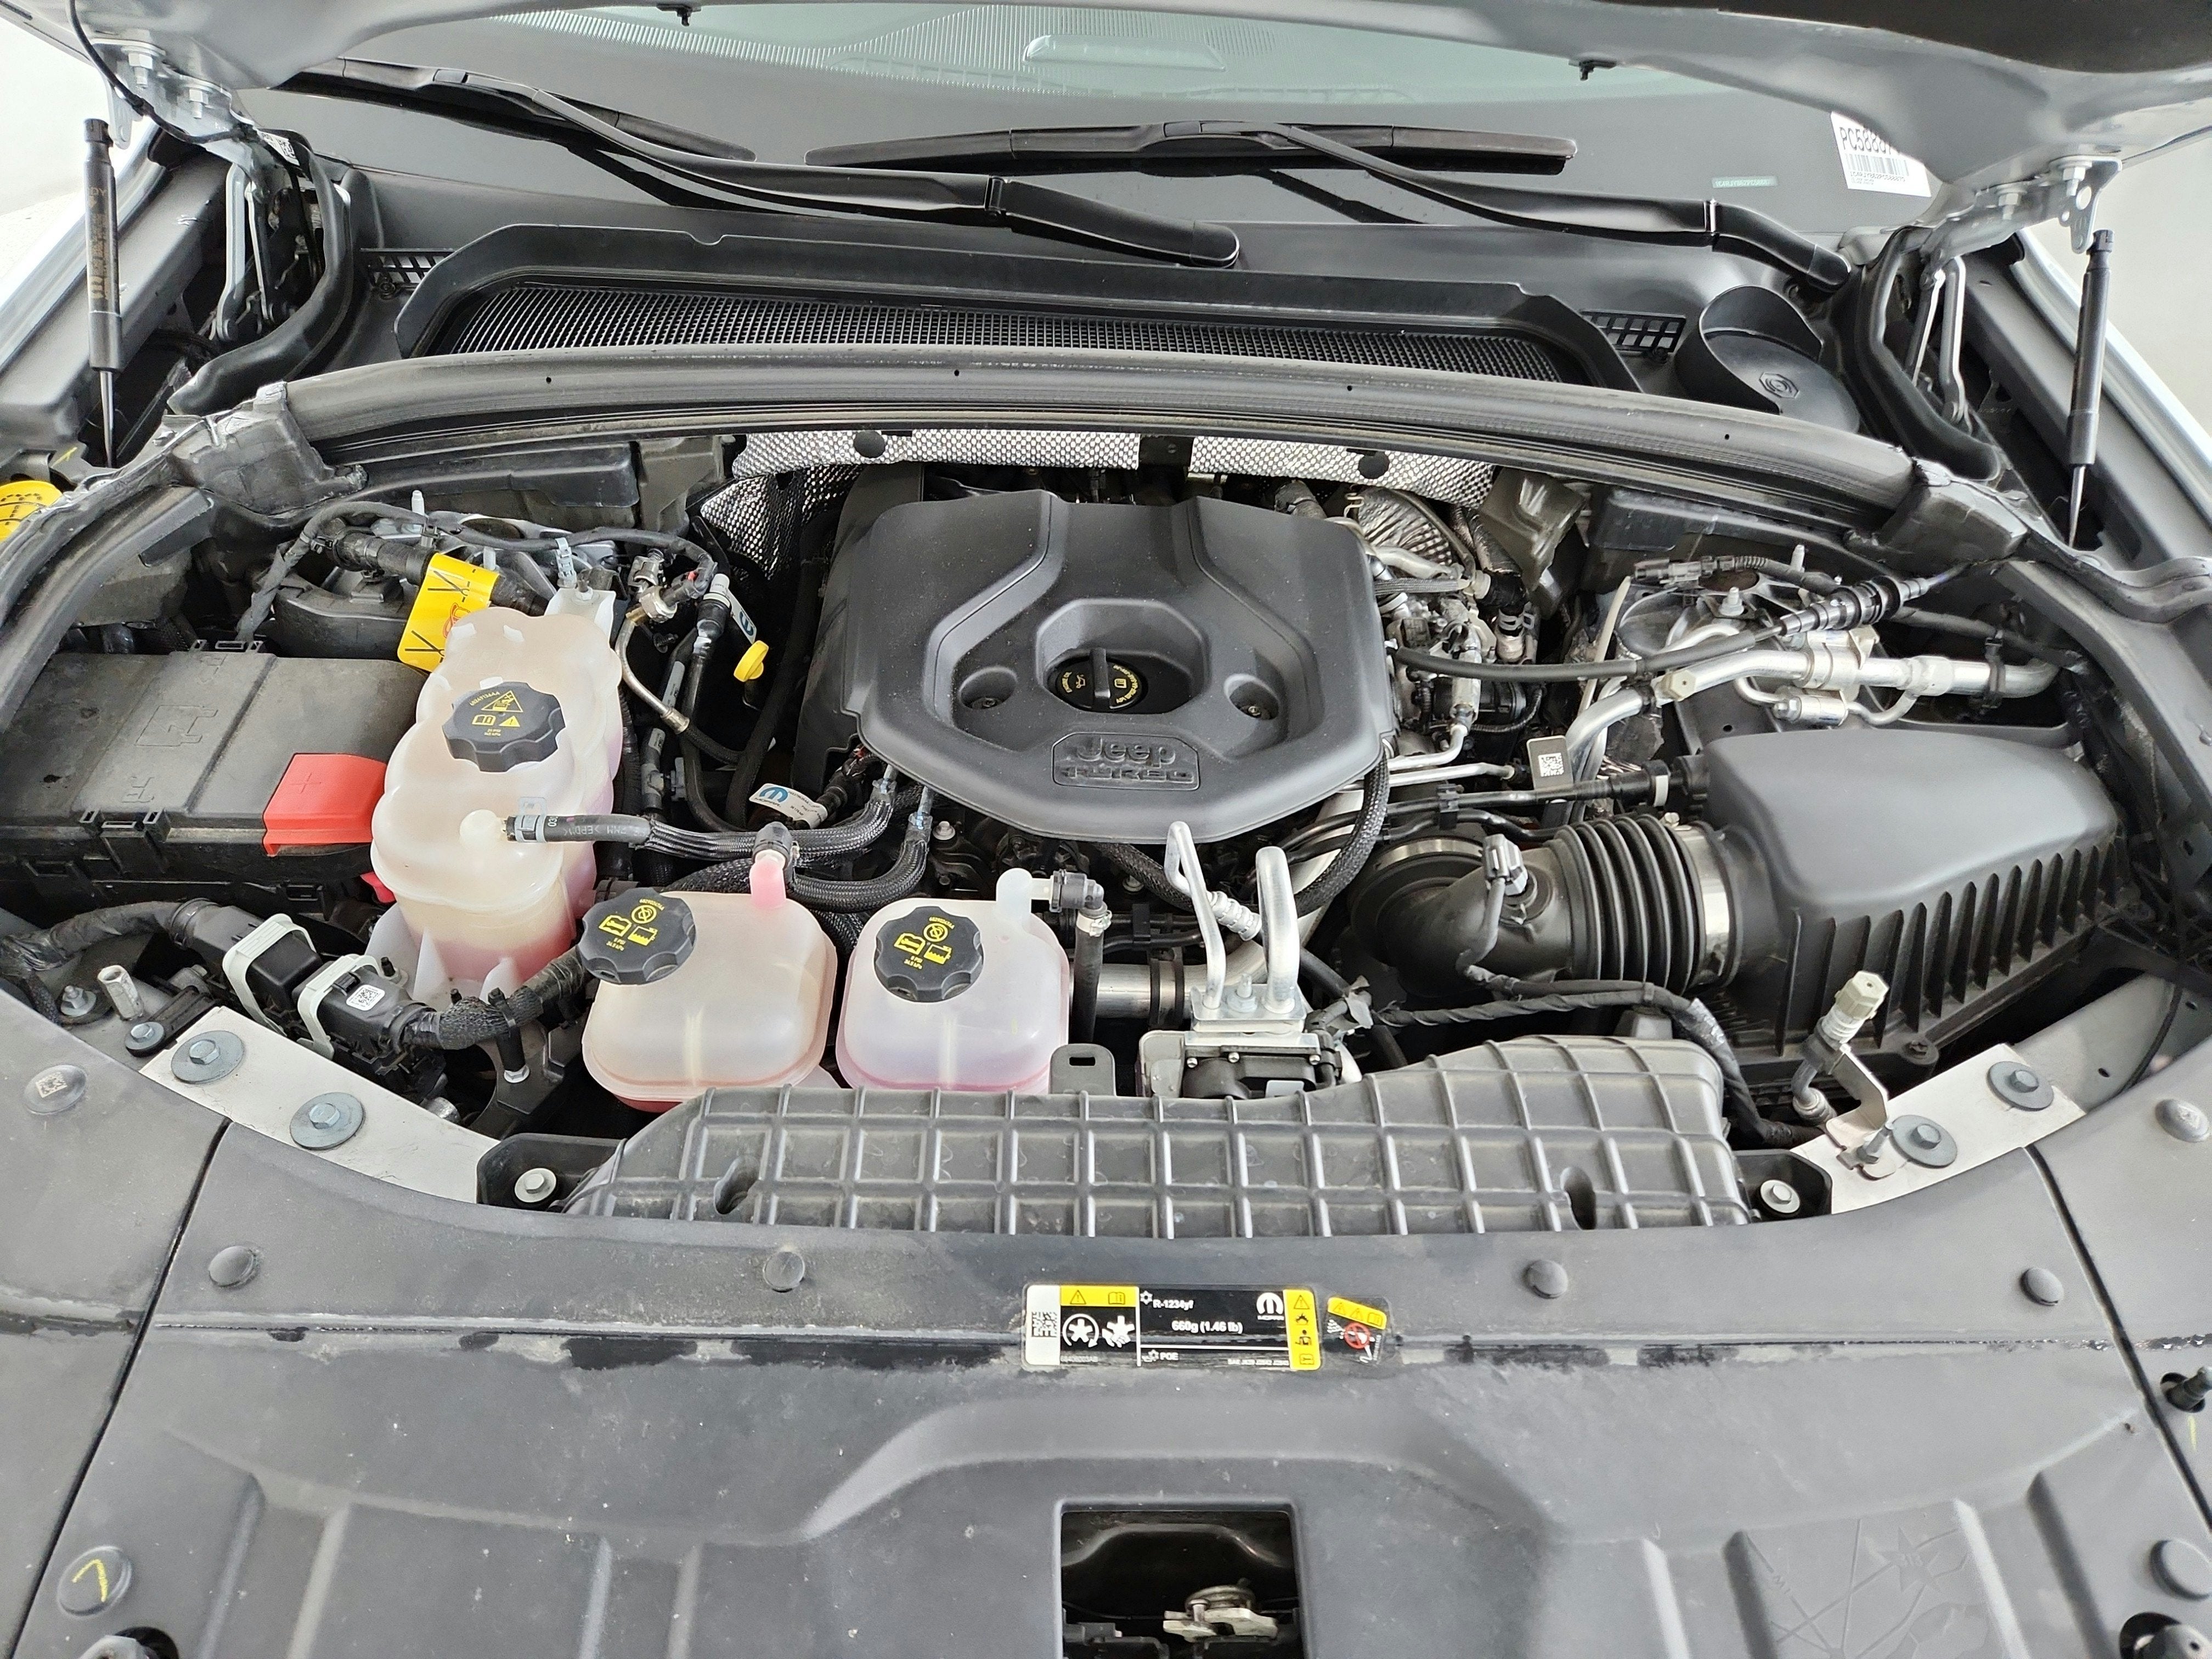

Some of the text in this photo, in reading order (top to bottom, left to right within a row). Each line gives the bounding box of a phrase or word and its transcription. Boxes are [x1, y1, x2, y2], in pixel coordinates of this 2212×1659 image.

[1077, 735, 1176, 769] Jeep
[1153, 1299, 1194, 1311] R-1234yf
[1171, 1320, 1243, 1334] 660g (1.46 lb)
[1160, 1352, 1179, 1361] POE
